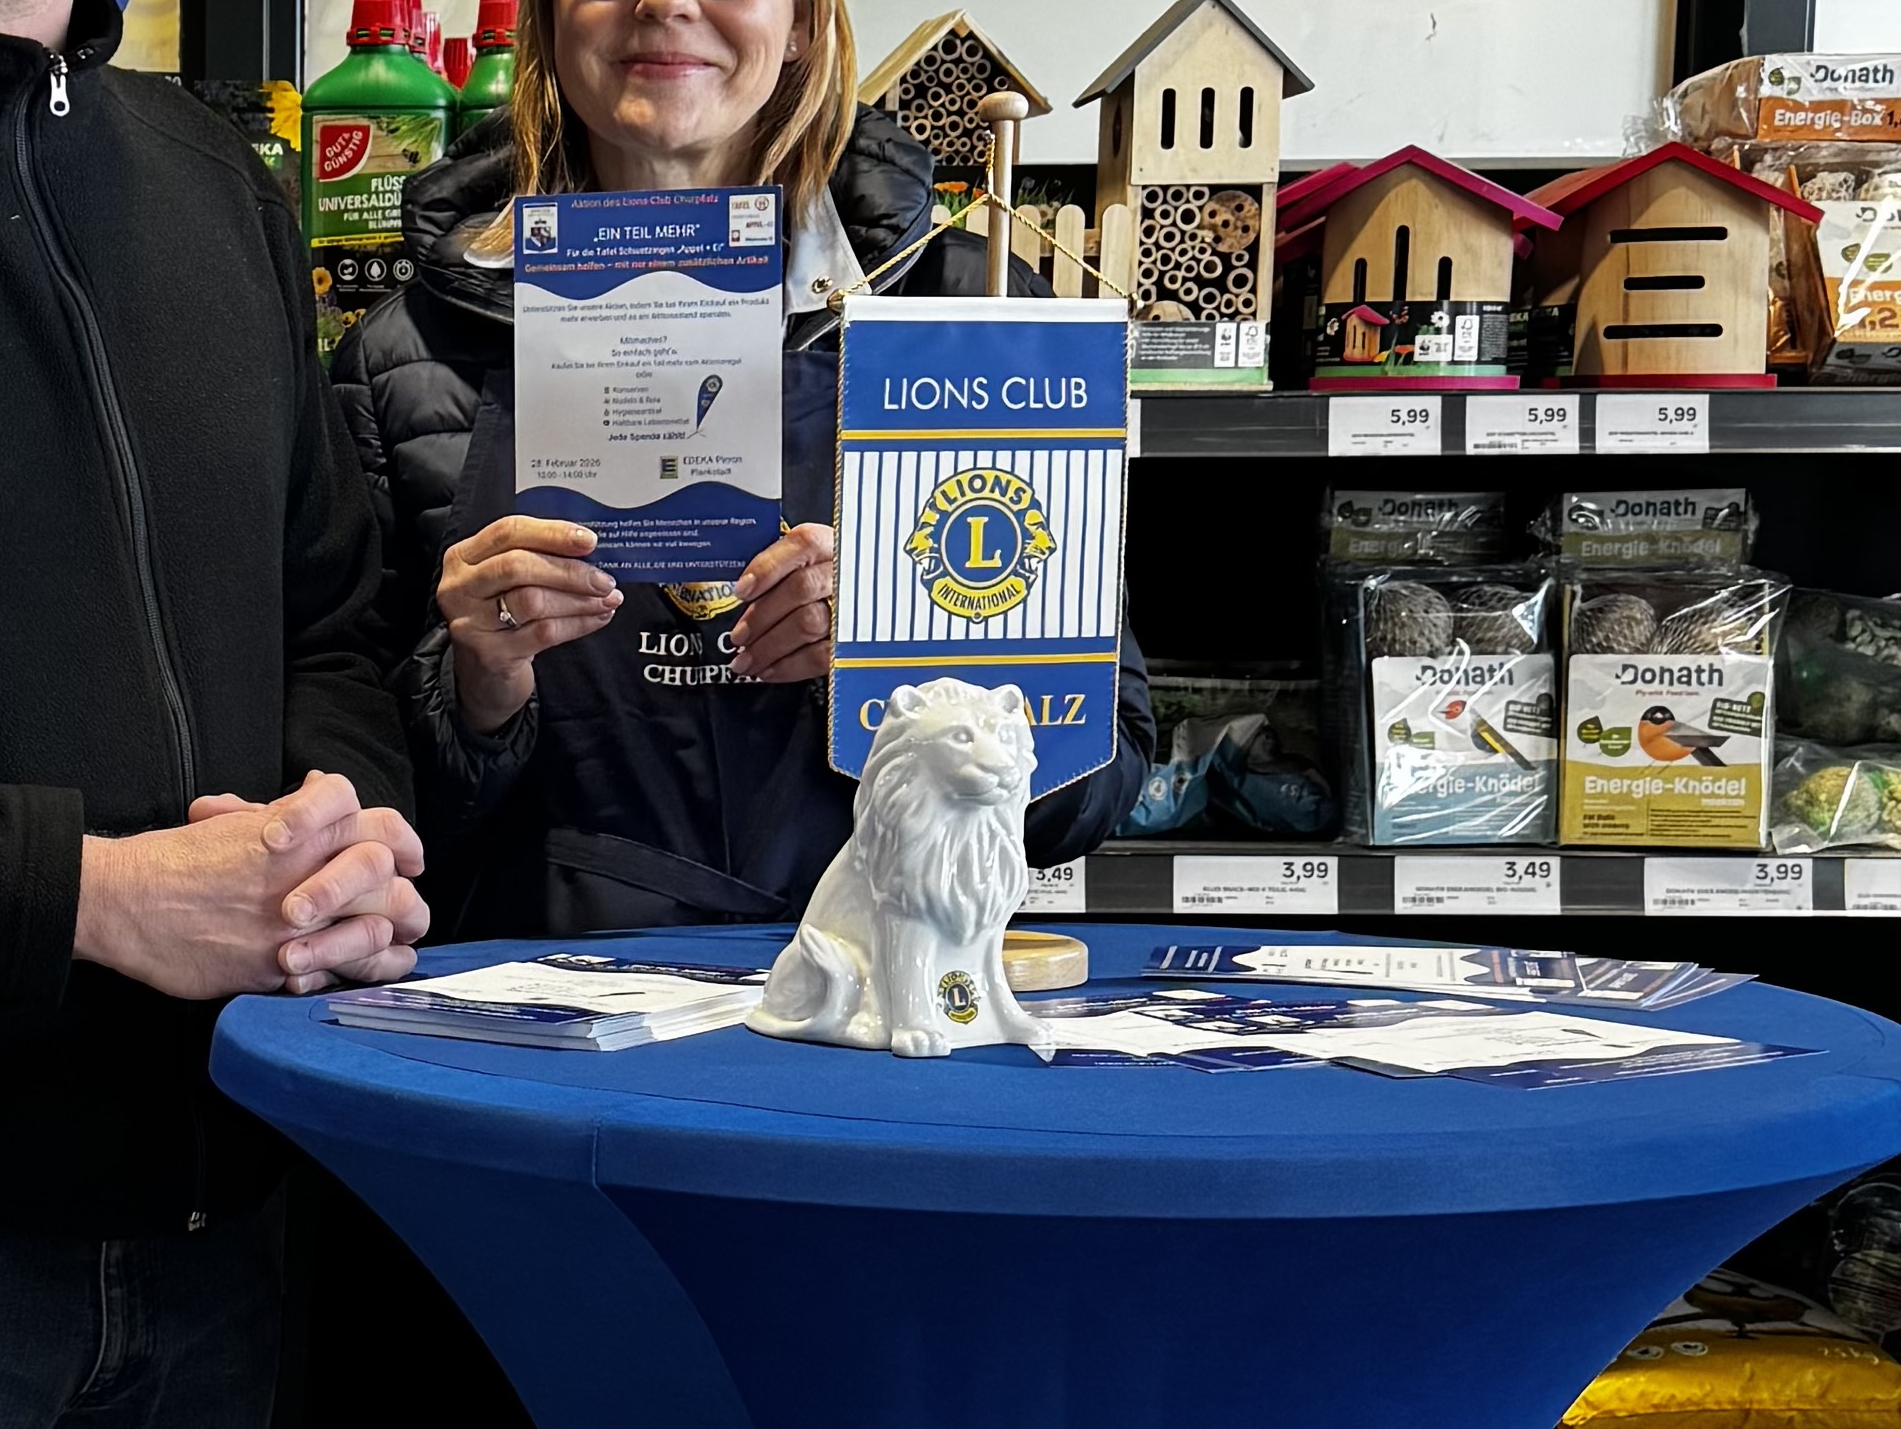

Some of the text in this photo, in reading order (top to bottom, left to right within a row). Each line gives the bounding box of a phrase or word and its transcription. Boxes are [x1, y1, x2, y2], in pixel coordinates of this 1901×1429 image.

[1810, 64, 1894, 85] Donath
[1774, 109, 1884, 127] Energie-Box
[371, 174, 406, 192] FLÜSS
[318, 192, 402, 212] UNIVERSALDÜ
[362, 211, 382, 220] ALLE
[624, 226, 651, 239] TEIL
[883, 377, 1089, 411] LIONS CLUB
[1390, 408, 1430, 426] 5,99
[1528, 407, 1567, 425] 5,99
[1658, 407, 1697, 424] 5,99
[939, 474, 1027, 506] LIONS
[1610, 497, 1696, 517] Donath
[964, 516, 1002, 568] L
[937, 583, 1022, 610] INTERNATIONAL
[1415, 662, 1514, 686] Donath
[1615, 663, 1724, 687] Donath
[1585, 775, 1746, 799] Energie-Knödel
[1282, 861, 1329, 883] 3,99
[1504, 861, 1551, 881] 3,49
[1755, 863, 1803, 883] 3,99
